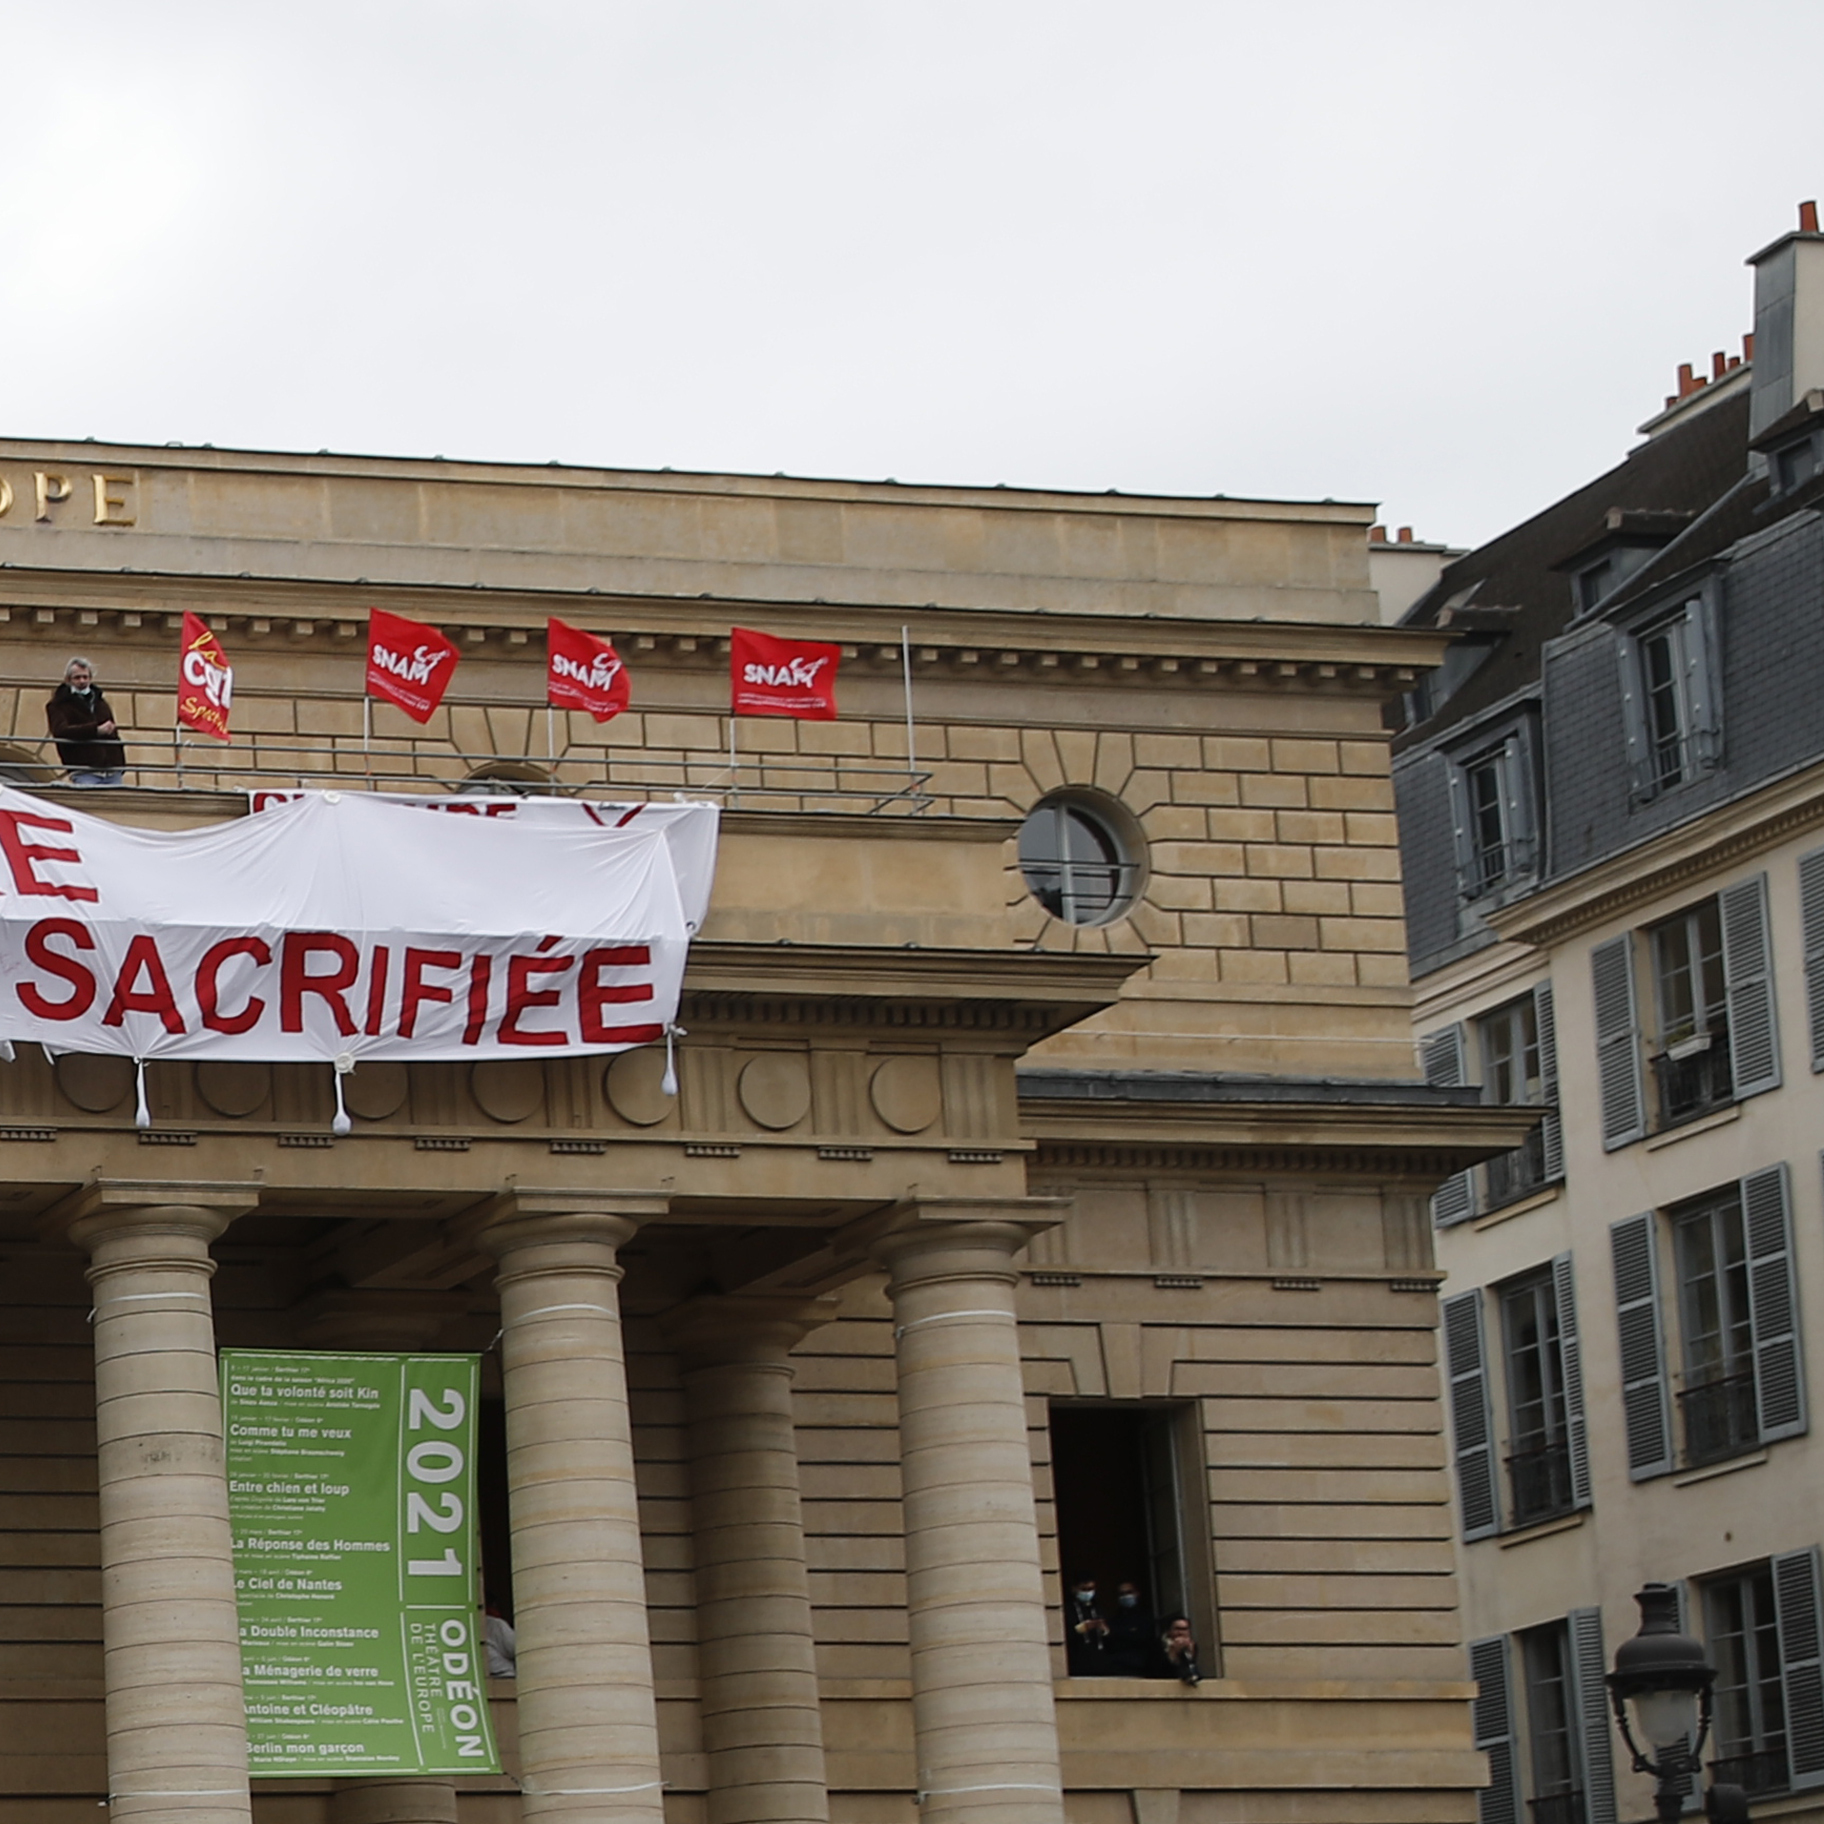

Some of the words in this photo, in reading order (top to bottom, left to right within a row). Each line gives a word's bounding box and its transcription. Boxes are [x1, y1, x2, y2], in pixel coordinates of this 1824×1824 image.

[15, 916, 666, 1048] SACRIFIÉE
[230, 1383, 258, 1397] Que
[260, 1385, 273, 1396] ta
[277, 1386, 326, 1398] volonté
[329, 1387, 354, 1399] soit
[357, 1388, 379, 1399] Kin
[230, 1423, 278, 1437] Comme
[281, 1425, 294, 1437] tu
[297, 1427, 318, 1438] me
[321, 1427, 352, 1439] veux
[229, 1480, 263, 1493] Entre
[266, 1481, 300, 1494] chien
[304, 1483, 317, 1494] et
[321, 1483, 350, 1497] loup
[406, 1388, 466, 1577] 2021
[248, 1537, 303, 1552] Réponse
[306, 1539, 330, 1551] des
[333, 1540, 391, 1551] Hommes
[248, 1578, 273, 1590] Ciel
[277, 1579, 293, 1590] de
[297, 1579, 343, 1591] Nantes
[251, 1625, 297, 1638] Double
[301, 1626, 379, 1639] Inconstance
[410, 1623, 424, 1646] DE
[424, 1623, 443, 1698] THÉÂTRE
[254, 1664, 323, 1678] Ménagerie
[325, 1665, 342, 1677] de
[345, 1667, 379, 1677] verre
[412, 1653, 435, 1734] L'EUROPE
[440, 1619, 485, 1758] ODÉON
[293, 1705, 307, 1715] et
[309, 1703, 374, 1717] Cléopâtre
[286, 1743, 315, 1753] mon
[318, 1742, 365, 1756] garçon
